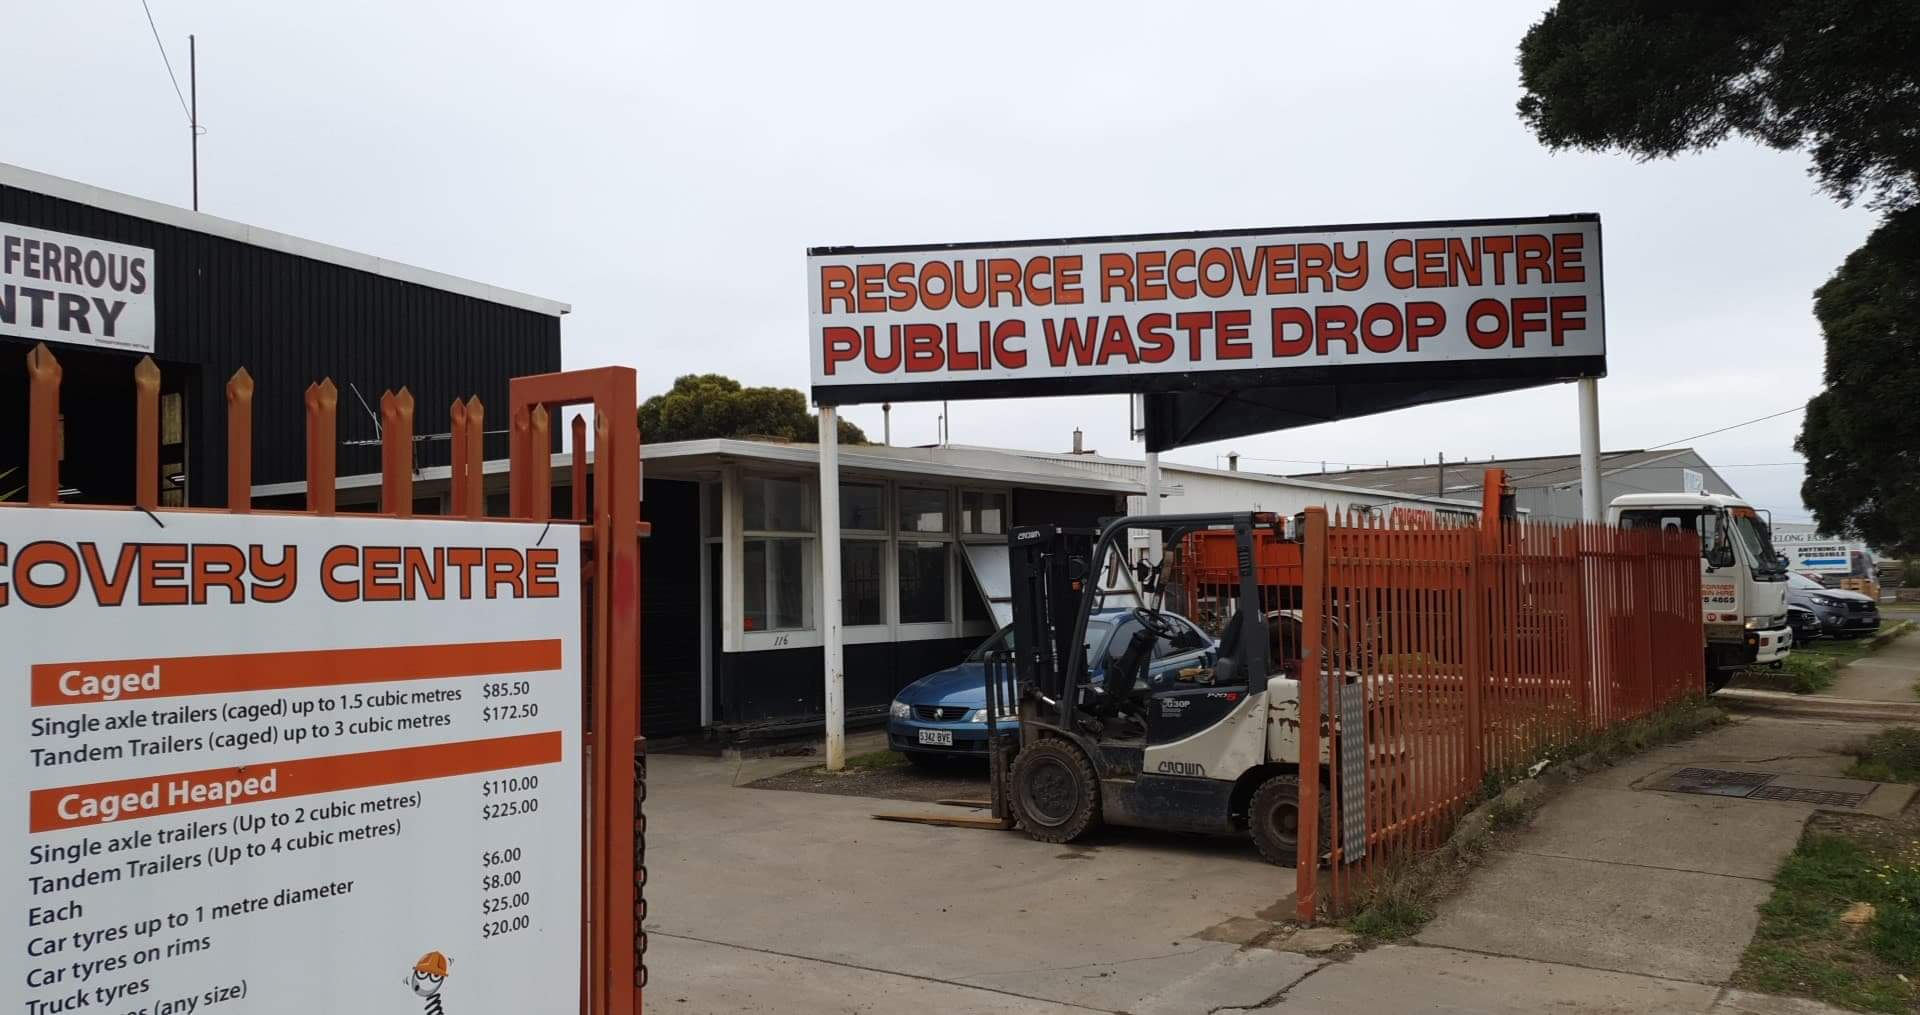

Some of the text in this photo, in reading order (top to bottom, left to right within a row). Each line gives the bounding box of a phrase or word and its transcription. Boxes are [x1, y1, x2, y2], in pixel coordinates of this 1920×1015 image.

[4, 235, 147, 295] FERROUS
[820, 232, 1586, 314] RESOURCE RECOVERY CENTRE
[822, 296, 1587, 376] PUBLIC WASTE DROP OFF
[1017, 530, 1041, 540] CROWN
[1772, 534, 1804, 542] ELONG
[0, 540, 560, 609] OVERY CENTRE
[774, 632, 790, 647] 116
[58, 665, 161, 701] Caged
[483, 681, 530, 699] $85.50
[31, 688, 462, 739] Single axle trailers (caged) up to 1.5 cubic metres
[483, 703, 539, 722] $172.50
[30, 712, 451, 768] Tandem Trailers (caged) up to 3 cubic metres
[483, 775, 539, 796] $110.00
[1158, 760, 1206, 776] CROWN
[57, 768, 277, 822] Caged Heaped
[483, 798, 539, 820] $225.00
[29, 790, 422, 865] Single axle trailers (Up to 2 cubic metres)
[28, 818, 402, 896] Tandem Trailers (Up to 4 cubic metres)
[483, 847, 522, 867] $6.00
[483, 870, 522, 891] $8.00
[27, 879, 355, 958] Car tyres up to 1 metre diameter
[28, 900, 83, 927] Each
[483, 892, 530, 914] $25.00
[483, 915, 530, 939] $20.00
[26, 935, 212, 989] Car tyres on rims
[26, 978, 151, 1015] Truck tyres
[154, 994, 199, 1015] (any
[203, 979, 249, 1006] size)
